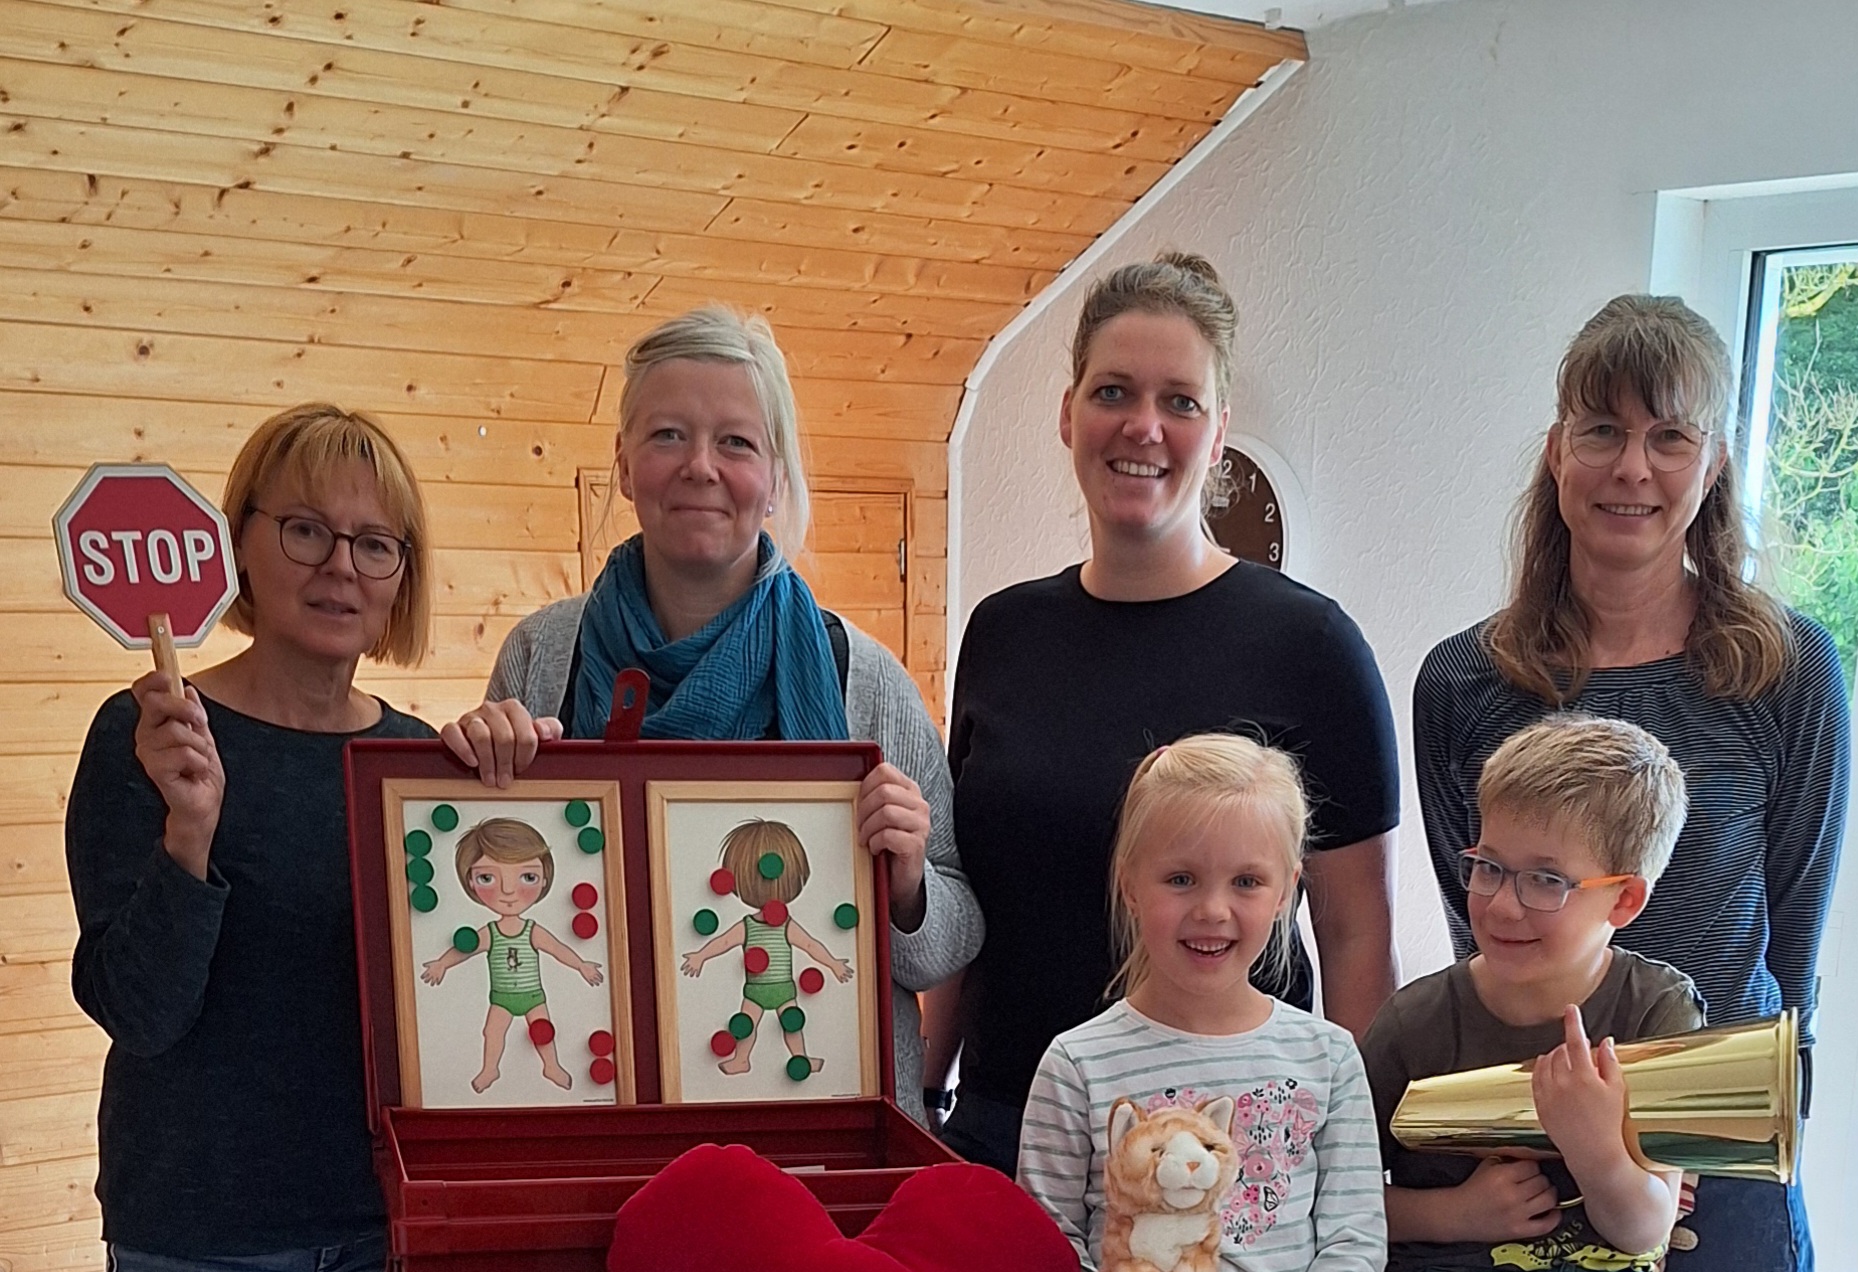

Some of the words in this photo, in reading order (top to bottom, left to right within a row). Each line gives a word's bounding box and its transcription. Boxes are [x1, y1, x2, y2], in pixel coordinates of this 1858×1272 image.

[1249, 472, 1257, 493] 1
[1264, 502, 1276, 523] 2
[79, 528, 215, 586] STOP
[1269, 542, 1280, 562] 3
